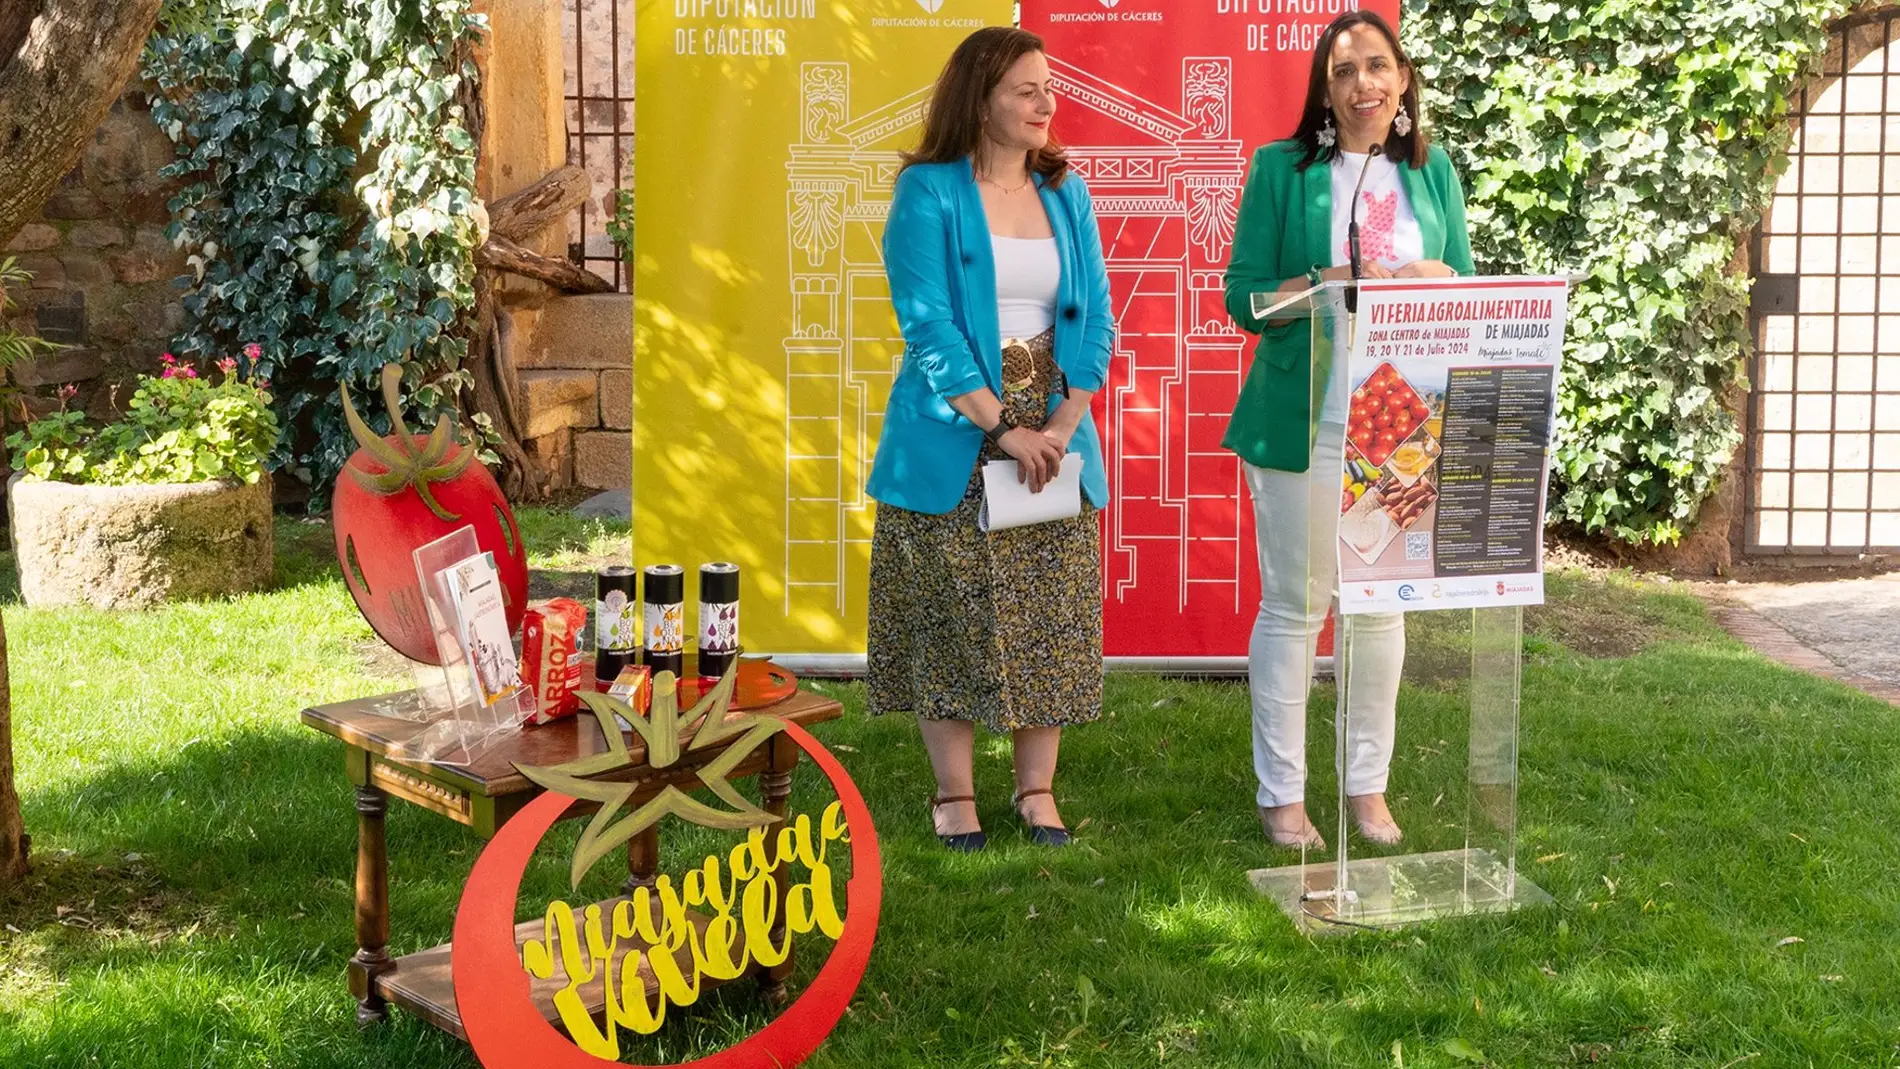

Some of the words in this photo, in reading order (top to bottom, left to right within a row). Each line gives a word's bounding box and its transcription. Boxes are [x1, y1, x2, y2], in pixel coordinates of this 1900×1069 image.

[872, 17, 926, 27] DIPUTACIÓN
[930, 18, 941, 27] DE
[943, 17, 985, 28] CÁCERES
[1050, 11, 1105, 22] DIPUTACIÓN
[1107, 12, 1119, 21] DE
[1121, 11, 1163, 21] CÁCERES
[675, 28, 697, 55] DE
[704, 24, 786, 55] CÁCERES
[1247, 24, 1269, 51] DE
[1276, 20, 1329, 51] CÁCE
[1371, 303, 1385, 324] VI
[1387, 302, 1425, 323] FERIA
[1427, 299, 1552, 322] AGROALIMENTARIA
[1368, 330, 1388, 342] ZONA
[1390, 329, 1420, 341] CENTRO
[1422, 329, 1431, 340] de
[1434, 327, 1470, 340] MIAJADAS
[1485, 324, 1499, 339] DE
[1501, 323, 1550, 340] MIAJADAS
[1366, 346, 1377, 358] 19,
[1380, 345, 1391, 356] 20
[1394, 344, 1401, 356] Y
[1403, 344, 1412, 356] 21
[1415, 344, 1424, 355] de
[1427, 343, 1445, 356] Julio
[1448, 342, 1469, 354] 2024
[544, 633, 567, 718] ARROZ
